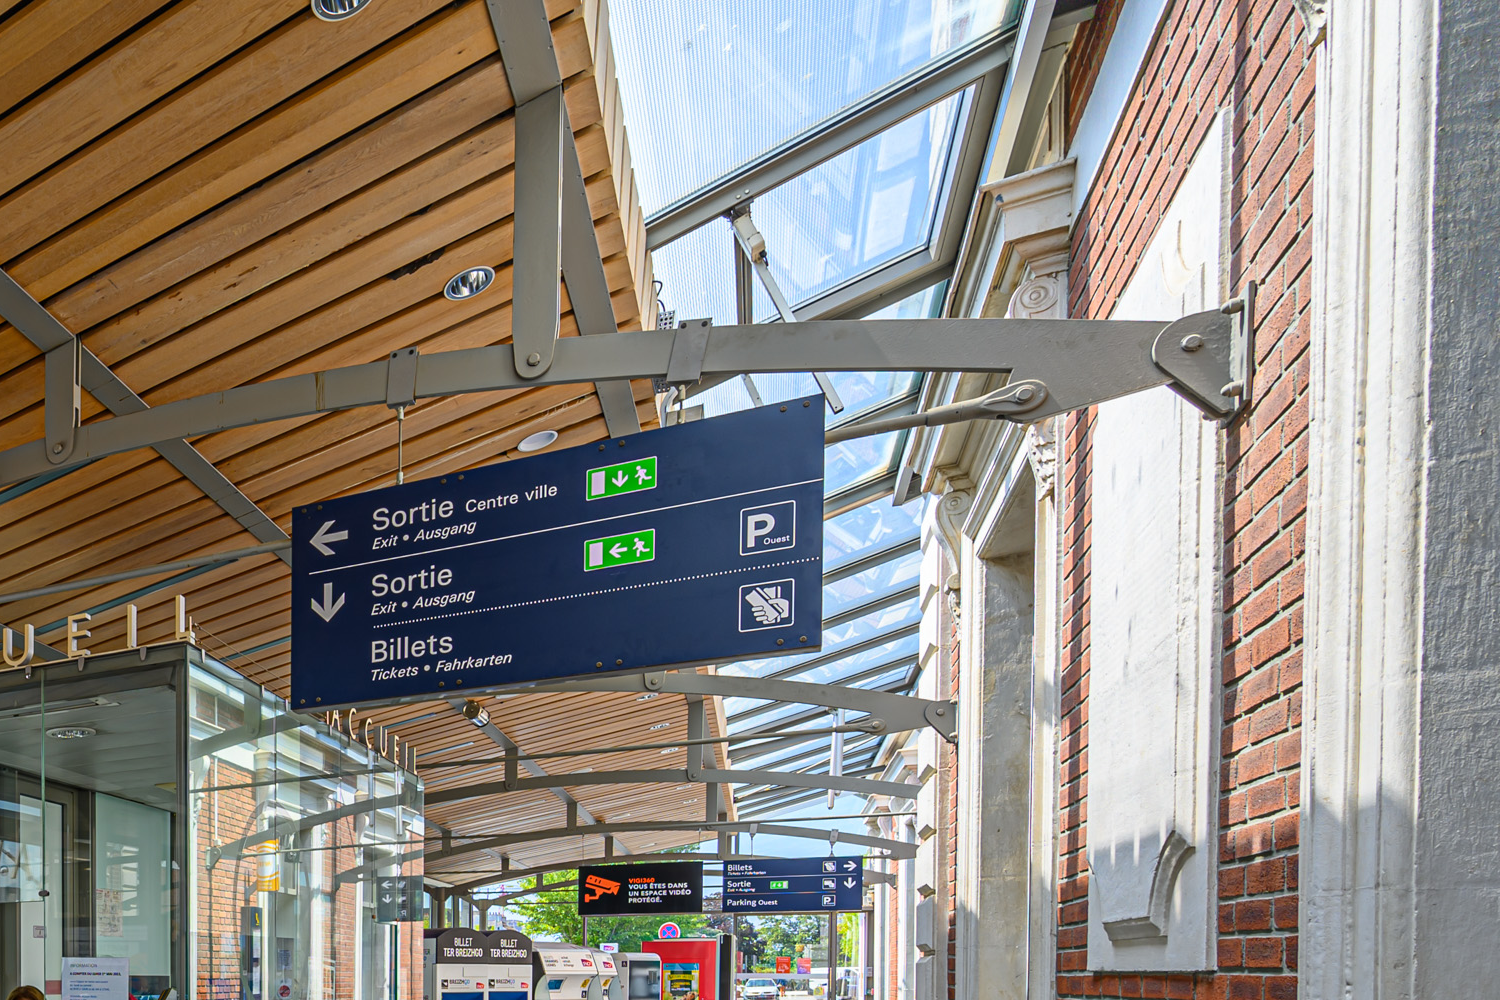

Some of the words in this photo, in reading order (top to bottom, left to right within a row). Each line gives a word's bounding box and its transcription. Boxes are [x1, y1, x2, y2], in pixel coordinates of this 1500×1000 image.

[372, 498, 454, 532] Sortie
[465, 494, 519, 513] Centre
[525, 483, 558, 501] ville
[372, 534, 399, 550] Exit
[414, 520, 477, 543] Ausgang
[763, 535, 790, 545] Ouest
[371, 564, 453, 597] Sortie
[370, 601, 398, 616] Exit
[412, 589, 476, 610] Ausgang
[371, 634, 453, 664] Billets
[371, 666, 419, 682] Tickets
[435, 652, 513, 673] Fahrkarten
[331, 707, 418, 775] ACCUEIL
[649, 881, 667, 889] ÊTES
[669, 888, 692, 896] VIDÉO
[727, 899, 757, 907] Parking
[453, 937, 473, 947] BILLET
[500, 939, 518, 948] BILLET
[443, 947, 455, 957] TER
[455, 947, 483, 958] BREIZHGO
[490, 949, 501, 958] TER
[501, 949, 528, 958] BREIZHGO
